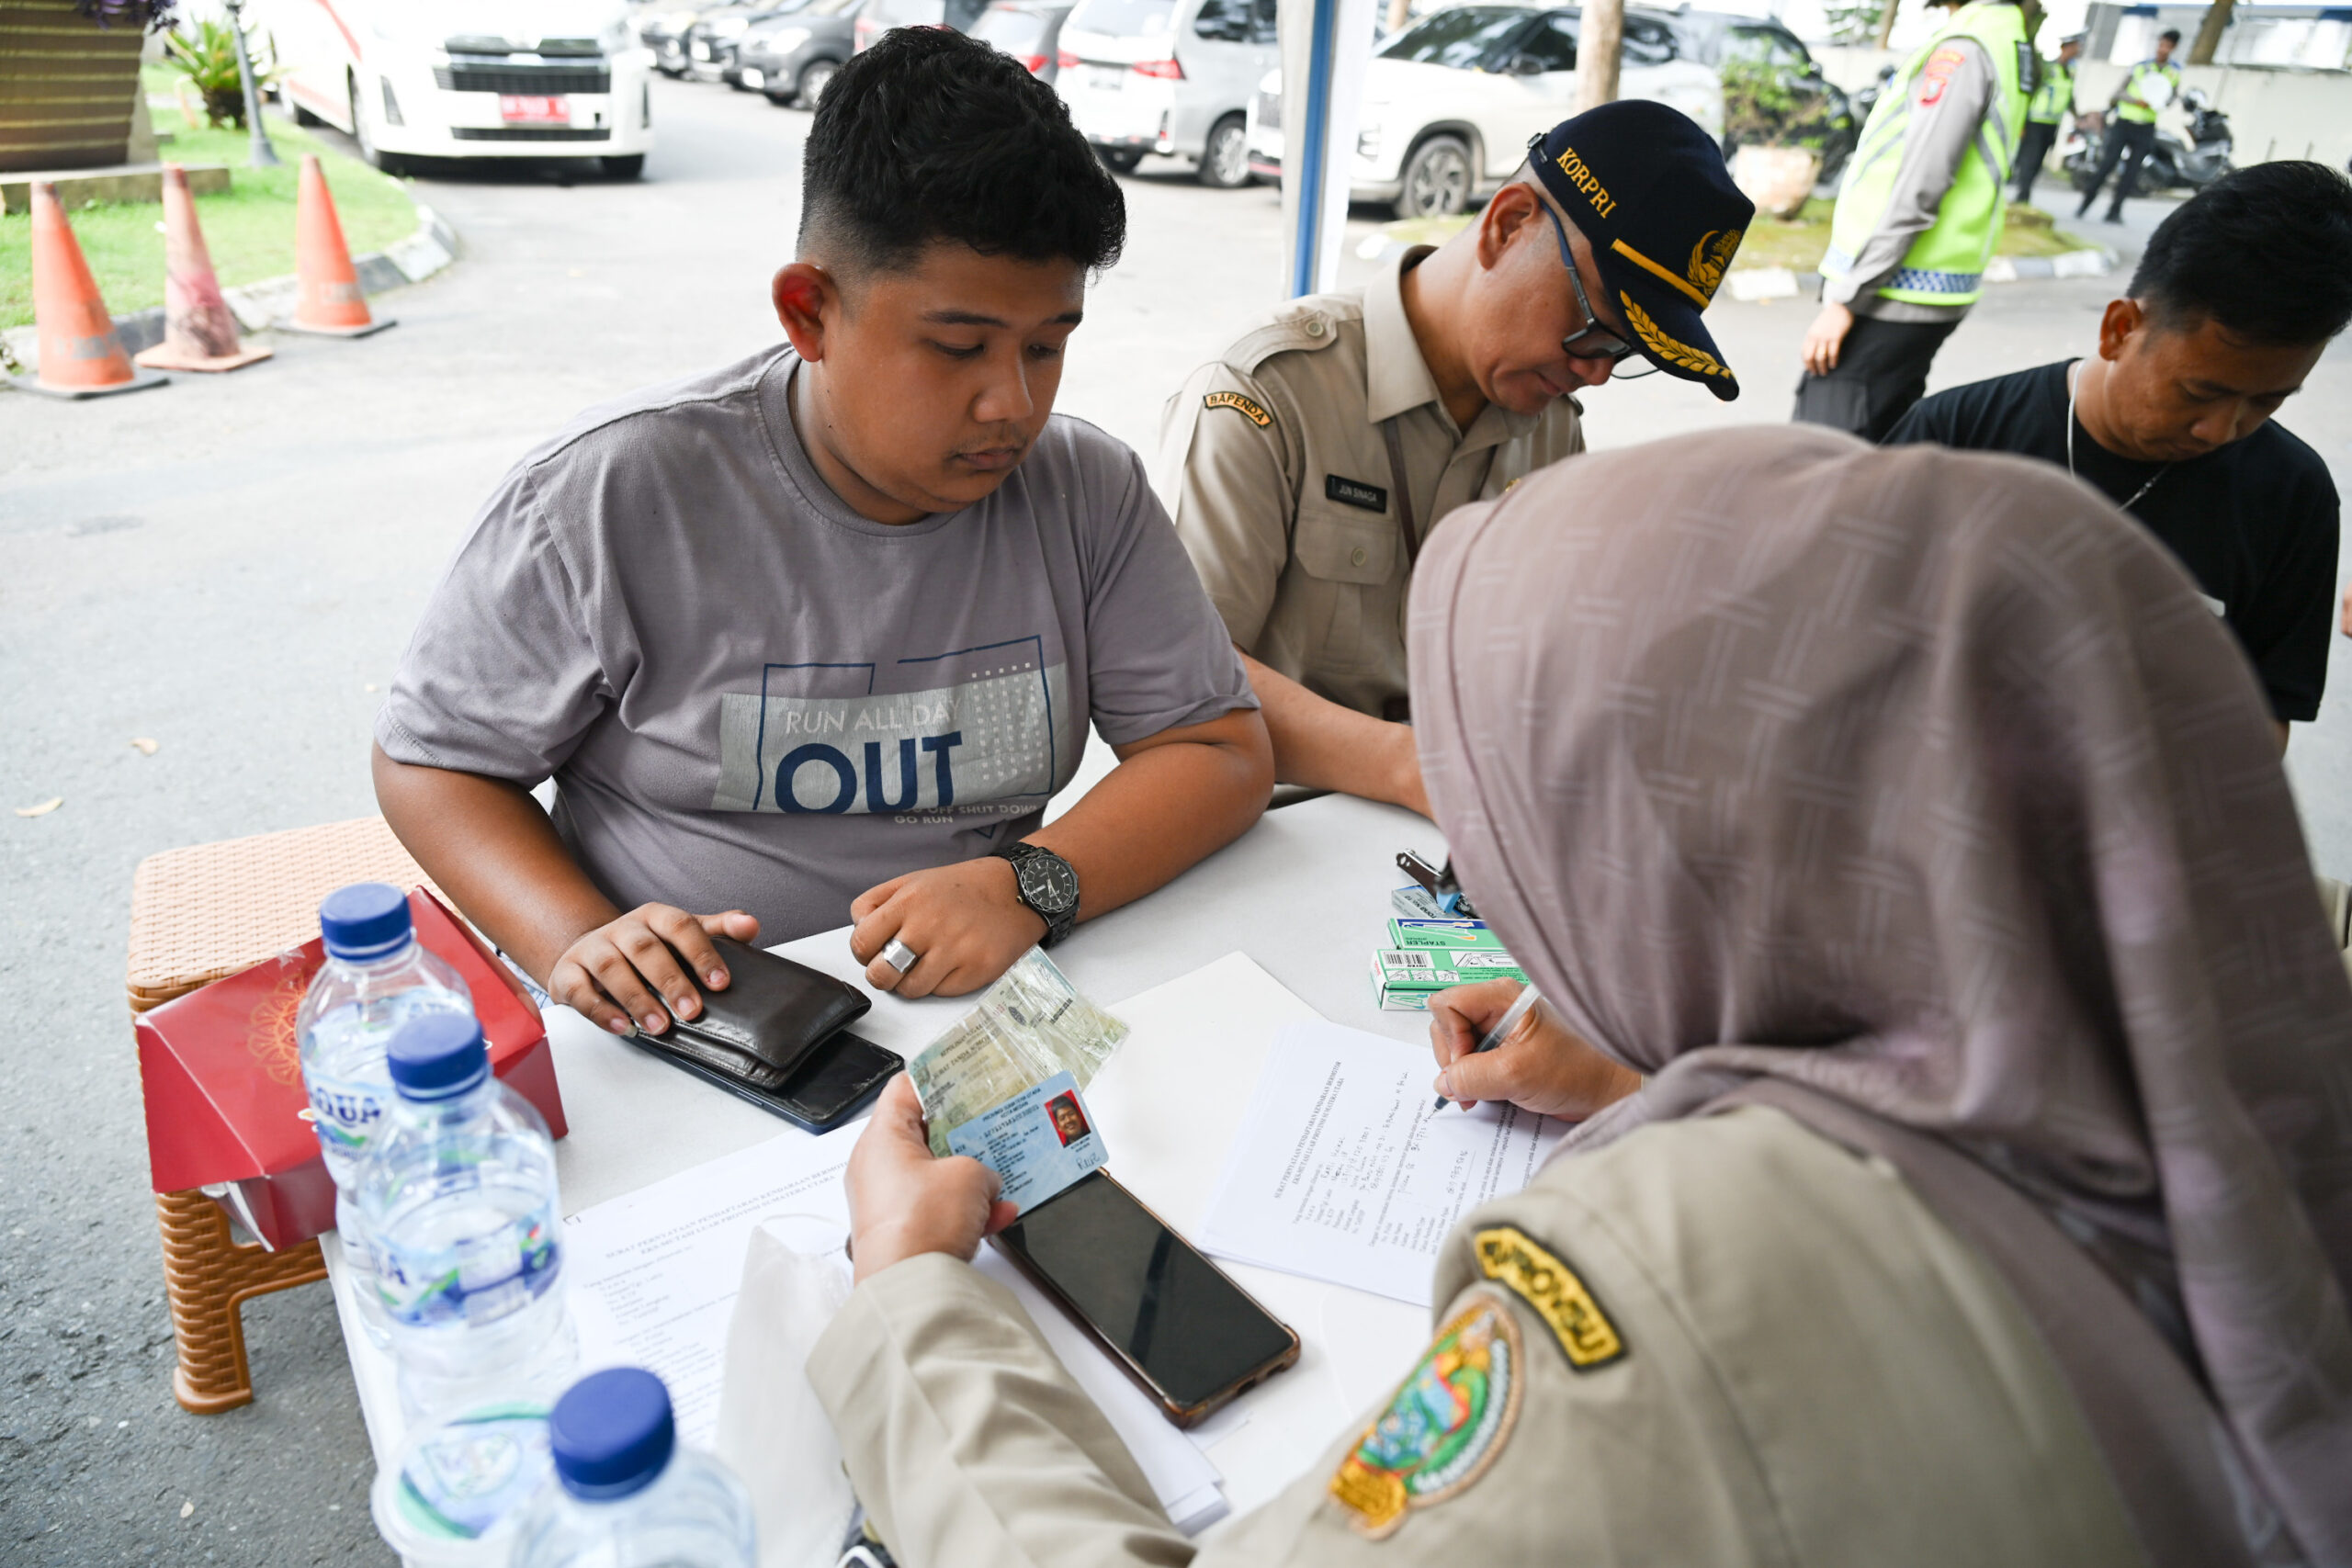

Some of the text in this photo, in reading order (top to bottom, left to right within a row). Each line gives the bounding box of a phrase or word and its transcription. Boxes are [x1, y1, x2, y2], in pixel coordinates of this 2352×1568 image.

[1556, 147, 1616, 219] KORPRI
[1210, 393, 1265, 423] BAPENDA
[1353, 487, 1377, 502] SINAGA
[786, 698, 961, 734] RUN ALL DAY
[775, 731, 963, 815] OUT
[894, 816, 954, 824] GO RUN
[959, 805, 994, 815] SHUT
[311, 1087, 381, 1129] QUA
